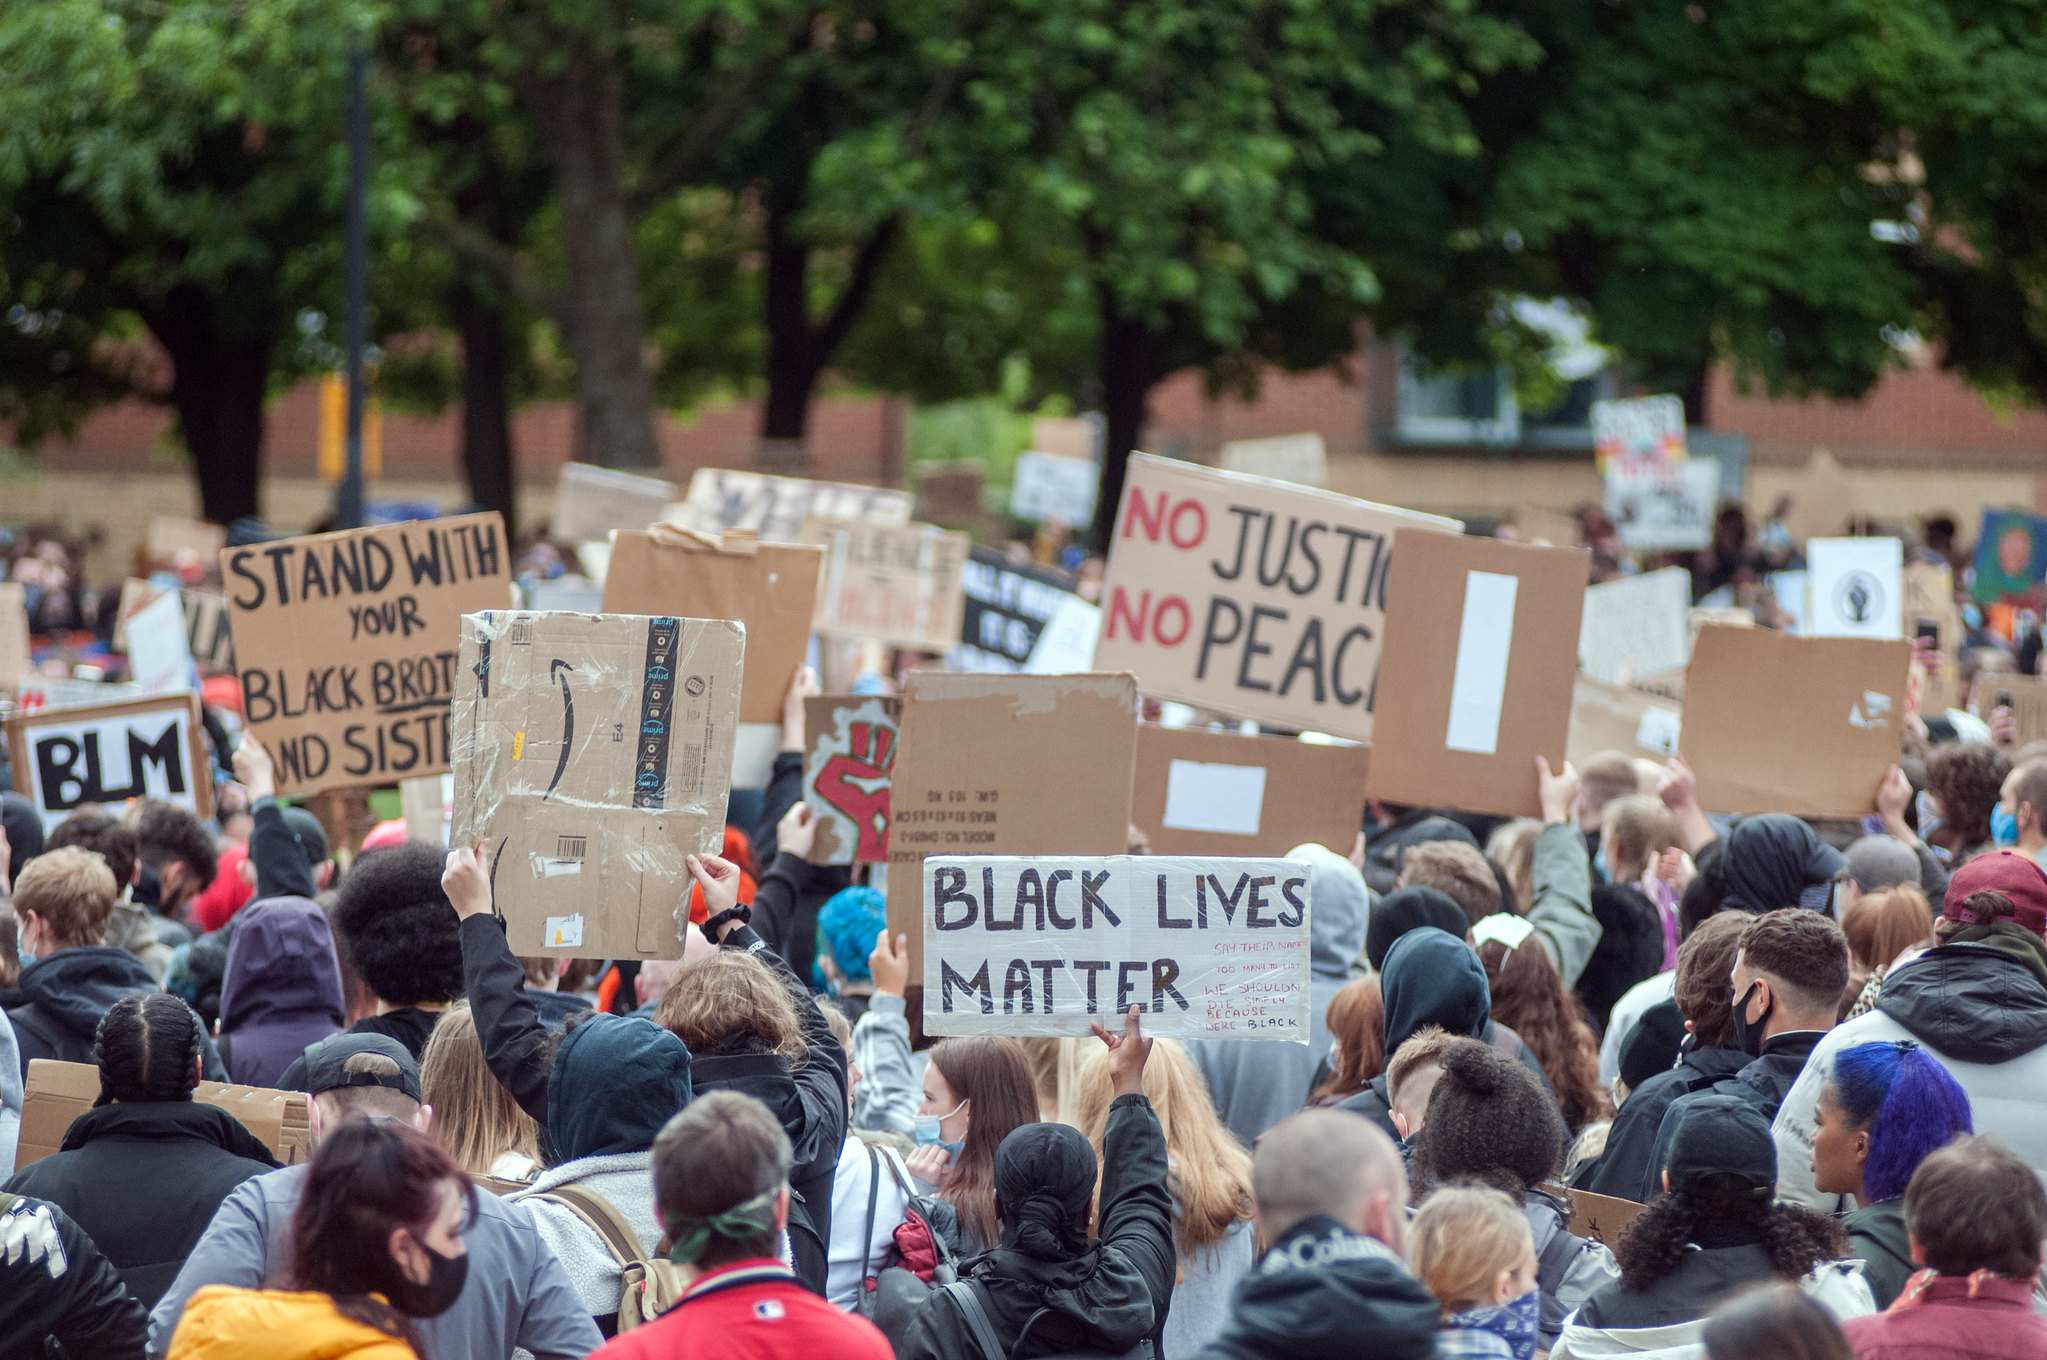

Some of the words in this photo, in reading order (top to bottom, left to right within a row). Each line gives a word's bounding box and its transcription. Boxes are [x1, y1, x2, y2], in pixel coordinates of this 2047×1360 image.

[1121, 486, 1208, 550] NO
[230, 535, 394, 611] STAND
[401, 523, 499, 586] WITH
[349, 595, 427, 640] YOUR
[1104, 585, 1192, 648] NO
[1194, 595, 1380, 714] PEAC
[242, 665, 364, 723] BLACK
[612, 723, 624, 743] E4
[36, 721, 186, 811] BLM
[934, 866, 1122, 931] BLACK
[1157, 872, 1307, 929] LIVES
[1214, 943, 1236, 956] SAY
[1240, 941, 1275, 953] THEIR
[1216, 966, 1236, 974] TOO
[1243, 964, 1266, 973] MANY
[941, 957, 1190, 1015] MATTER
[1205, 984, 1229, 996] WE
[1208, 999, 1235, 1010] DIE
[1205, 1021, 1237, 1031] WERE
[1247, 1018, 1299, 1029] BLACK
[1206, 1006, 1268, 1019] BECAUSE
